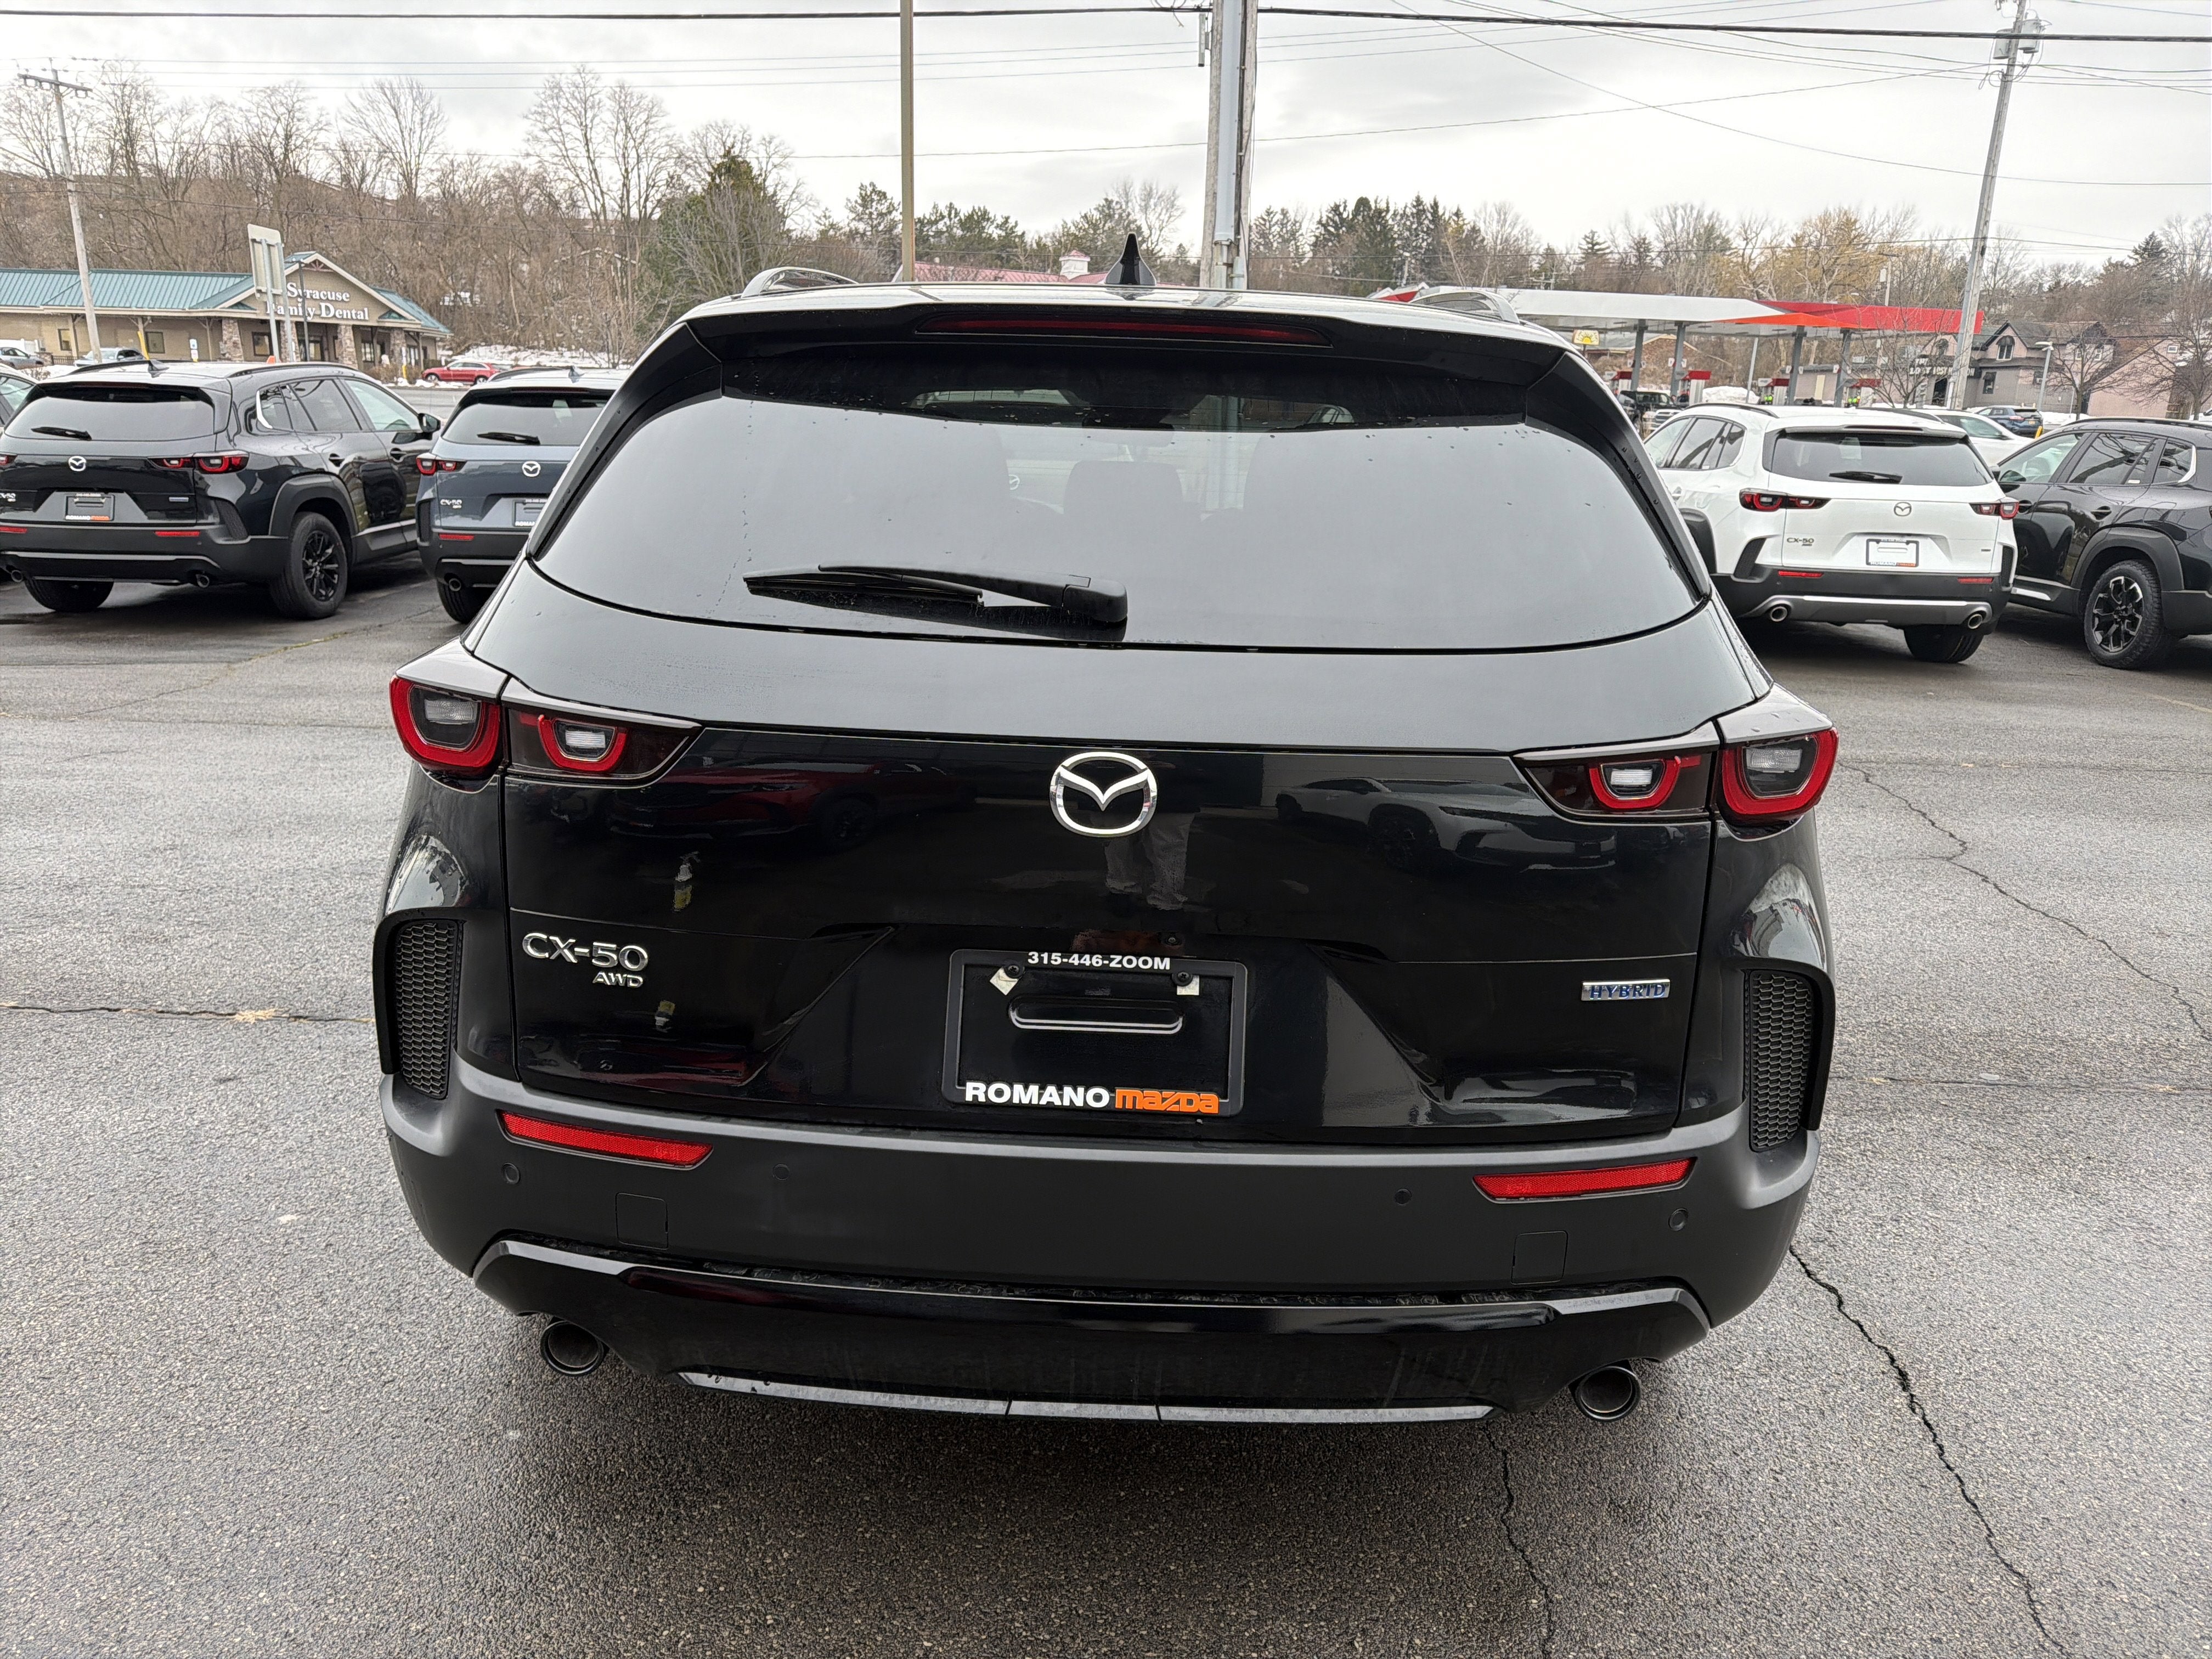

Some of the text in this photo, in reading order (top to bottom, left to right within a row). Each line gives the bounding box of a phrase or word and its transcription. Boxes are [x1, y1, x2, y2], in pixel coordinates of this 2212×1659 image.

[287, 282, 350, 302] Syracuse
[320, 302, 369, 320] Dental
[522, 933, 648, 972] CX-50
[1028, 951, 1170, 970] 315-446-ZOOM
[592, 971, 644, 988] AWD
[1590, 984, 1666, 1000] HYBRID
[965, 1081, 1219, 1114] ROMANO mazda
